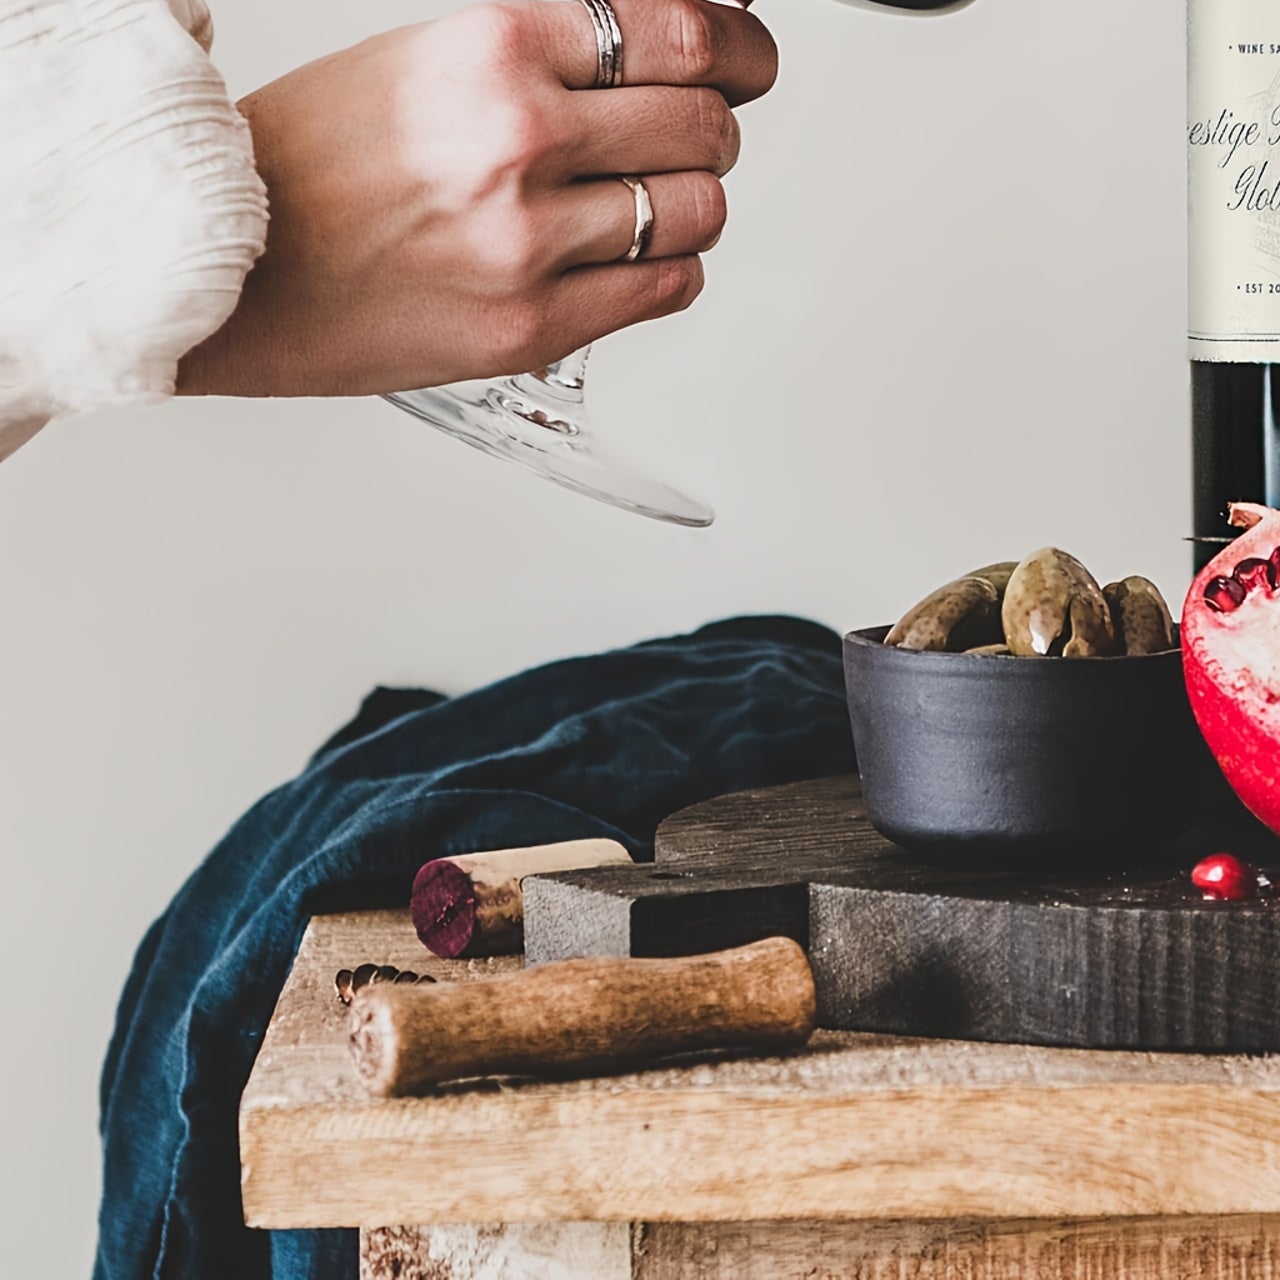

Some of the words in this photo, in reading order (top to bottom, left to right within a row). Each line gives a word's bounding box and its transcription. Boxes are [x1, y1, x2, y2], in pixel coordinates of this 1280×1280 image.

[1238, 43, 1264, 55] WINE
[1187, 108, 1261, 169] estige
[1245, 283, 1263, 294] EST
